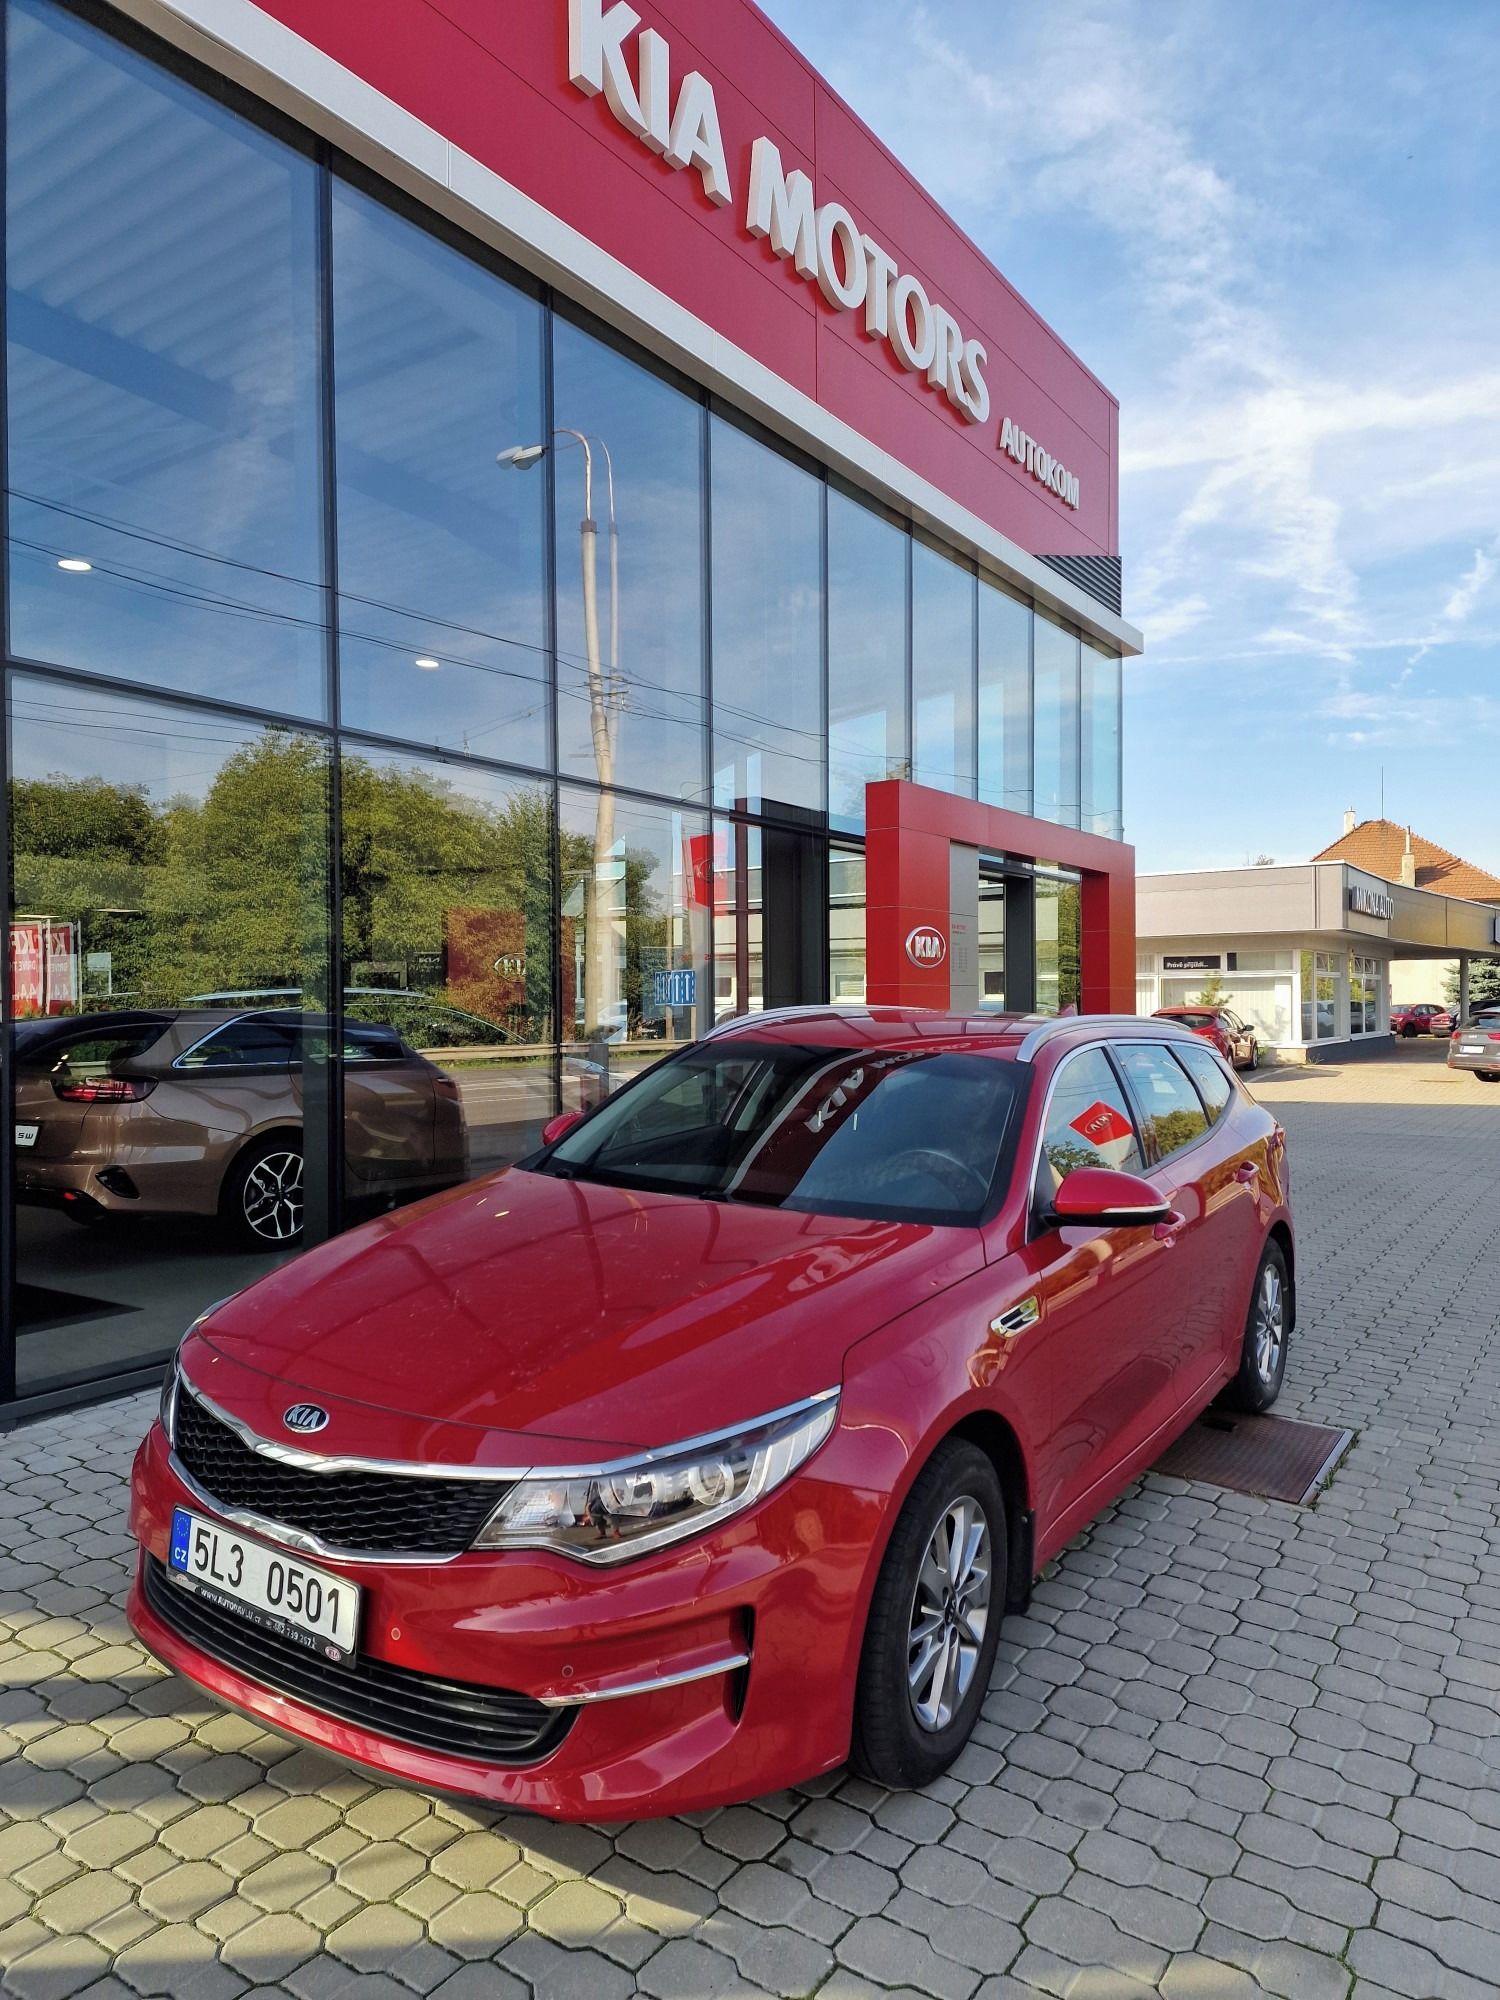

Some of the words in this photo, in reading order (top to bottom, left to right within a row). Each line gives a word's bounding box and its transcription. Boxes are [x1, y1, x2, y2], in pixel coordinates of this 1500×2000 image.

[568, 0, 733, 207] KIA
[745, 136, 990, 424] MOTORS
[999, 416, 1080, 511] AUTOKOM
[914, 935, 941, 958] KIA
[17, 1132, 34, 1140] SW
[287, 1406, 321, 1429] KIA
[174, 1546, 187, 1563] CZ
[194, 1527, 245, 1587] 5L3
[266, 1561, 340, 1634] 0501
